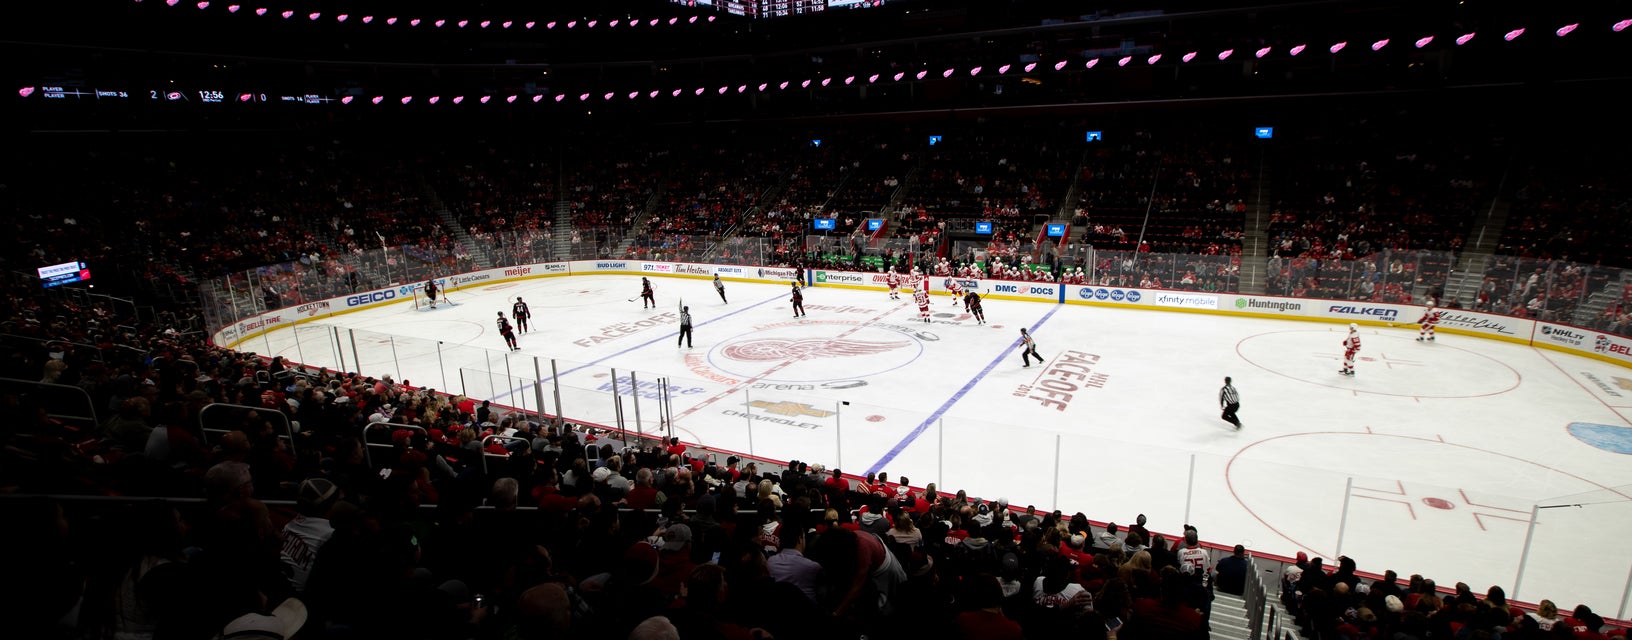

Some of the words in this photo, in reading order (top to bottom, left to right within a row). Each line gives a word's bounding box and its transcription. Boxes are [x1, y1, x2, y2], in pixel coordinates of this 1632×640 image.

[150, 91, 157, 99] 2
[199, 91, 223, 99] 12:56
[260, 93, 267, 101] 0
[505, 266, 531, 277] meijer
[675, 264, 686, 272] Tim
[687, 265, 709, 275] Hortons
[765, 270, 786, 278] Michigan
[819, 273, 862, 284] enterprise
[995, 284, 1017, 293] DMC
[1030, 286, 1054, 295] DOCS
[347, 289, 396, 307] GEICO
[1158, 295, 1185, 304] xfinity
[1185, 296, 1216, 306] mobile
[296, 301, 330, 314] HOCKEYTOWN
[1248, 298, 1301, 312] Huntington
[1329, 305, 1398, 317] FALKEN
[266, 316, 281, 325] TIRE
[752, 382, 815, 391] arena
[1029, 350, 1101, 412] FACE-OFF
[722, 409, 823, 430] CHEVROLET
